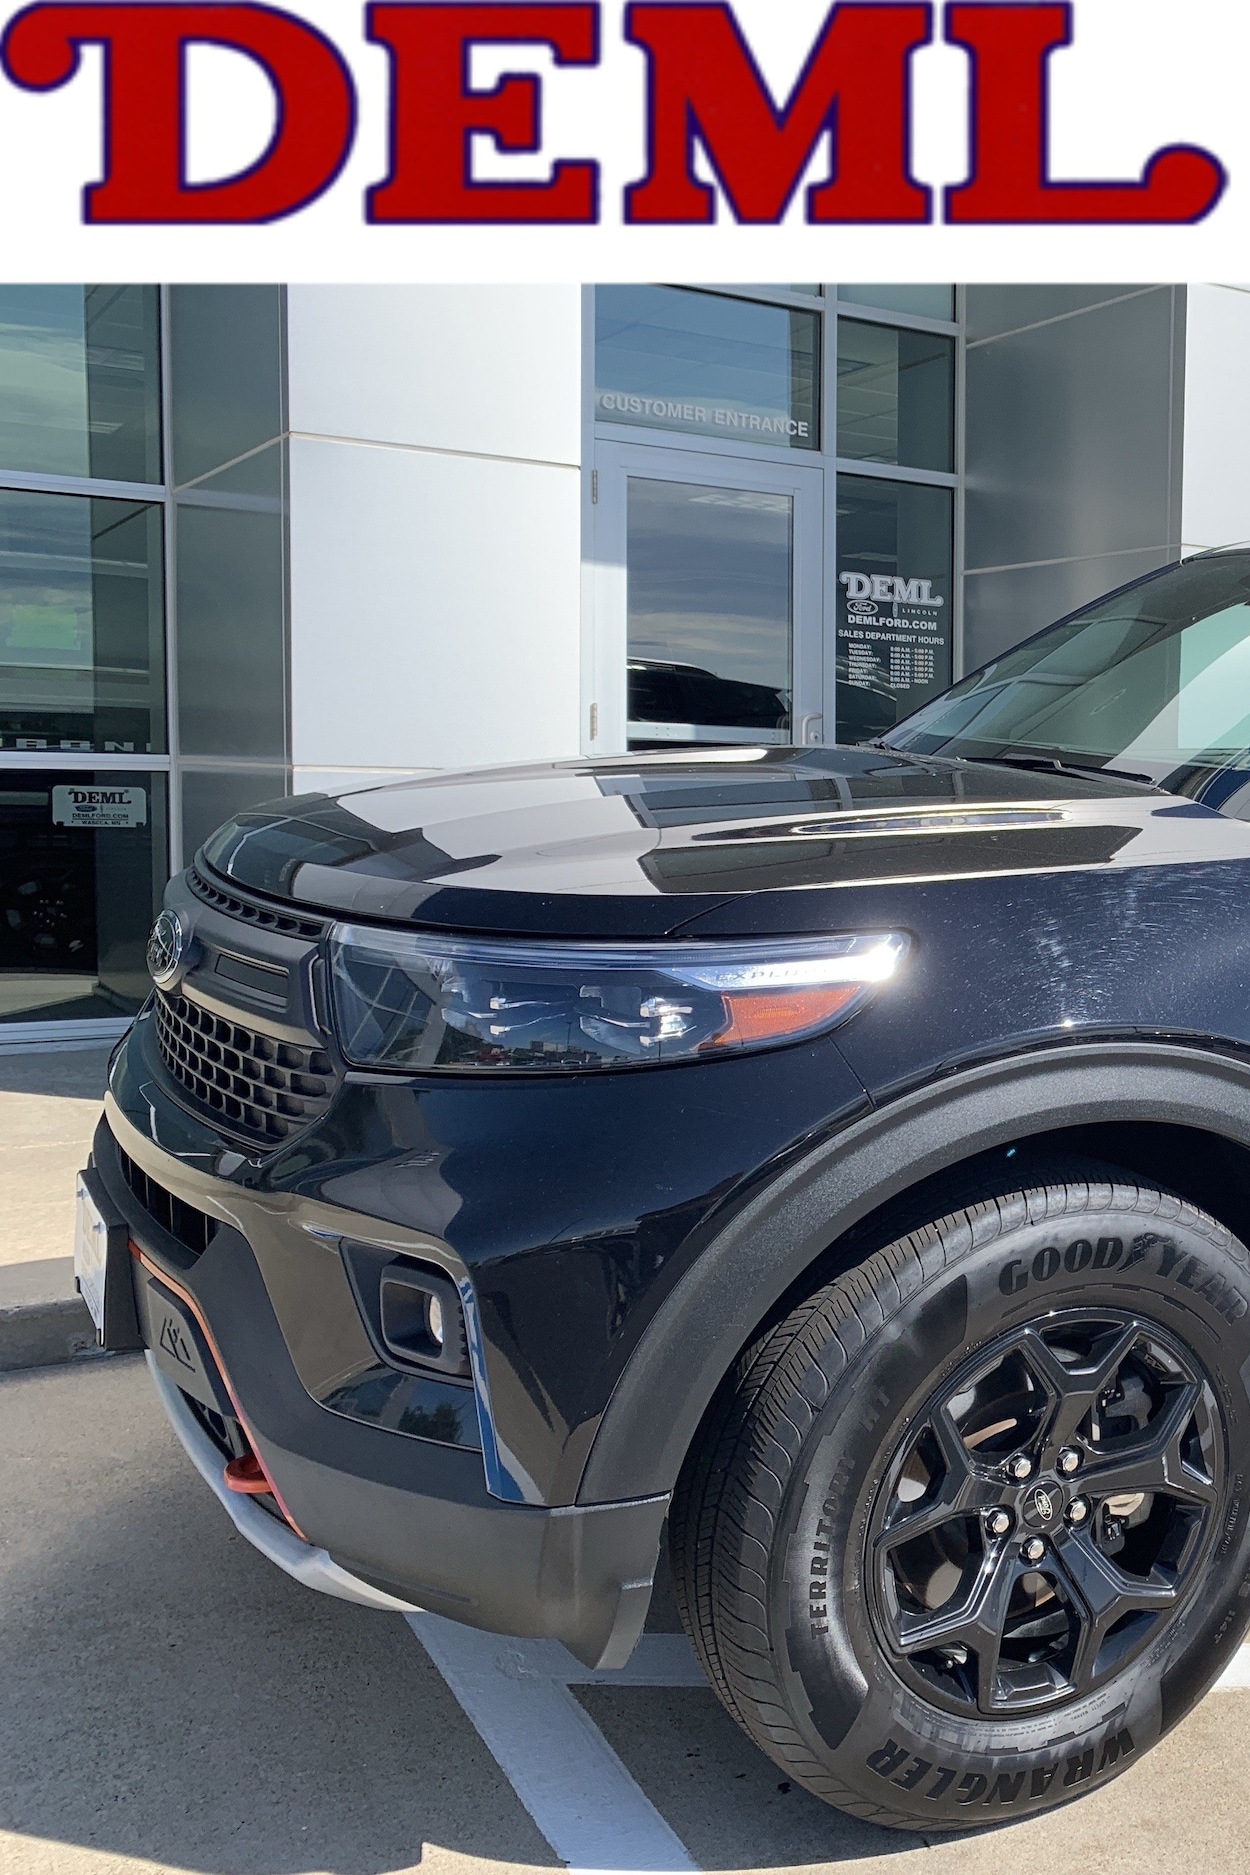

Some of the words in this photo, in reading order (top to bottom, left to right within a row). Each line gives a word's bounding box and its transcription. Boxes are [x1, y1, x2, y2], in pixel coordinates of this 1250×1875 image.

[602, 393, 707, 422] CUSTOMER
[714, 409, 809, 437] ENTRANCE
[839, 570, 945, 607] DEML
[847, 614, 937, 631] DEMLFORD.COM
[902, 607, 938, 616] LINCOLN
[838, 629, 864, 639] SALES
[865, 631, 917, 643] DEPARTMENT
[917, 636, 945, 645] HOURS
[68, 790, 132, 804] DEML
[998, 1232, 1249, 1327] GOODYEAR
[809, 1450, 856, 1640] TERRITORY
[866, 1728, 1135, 1806] WRANGLER
